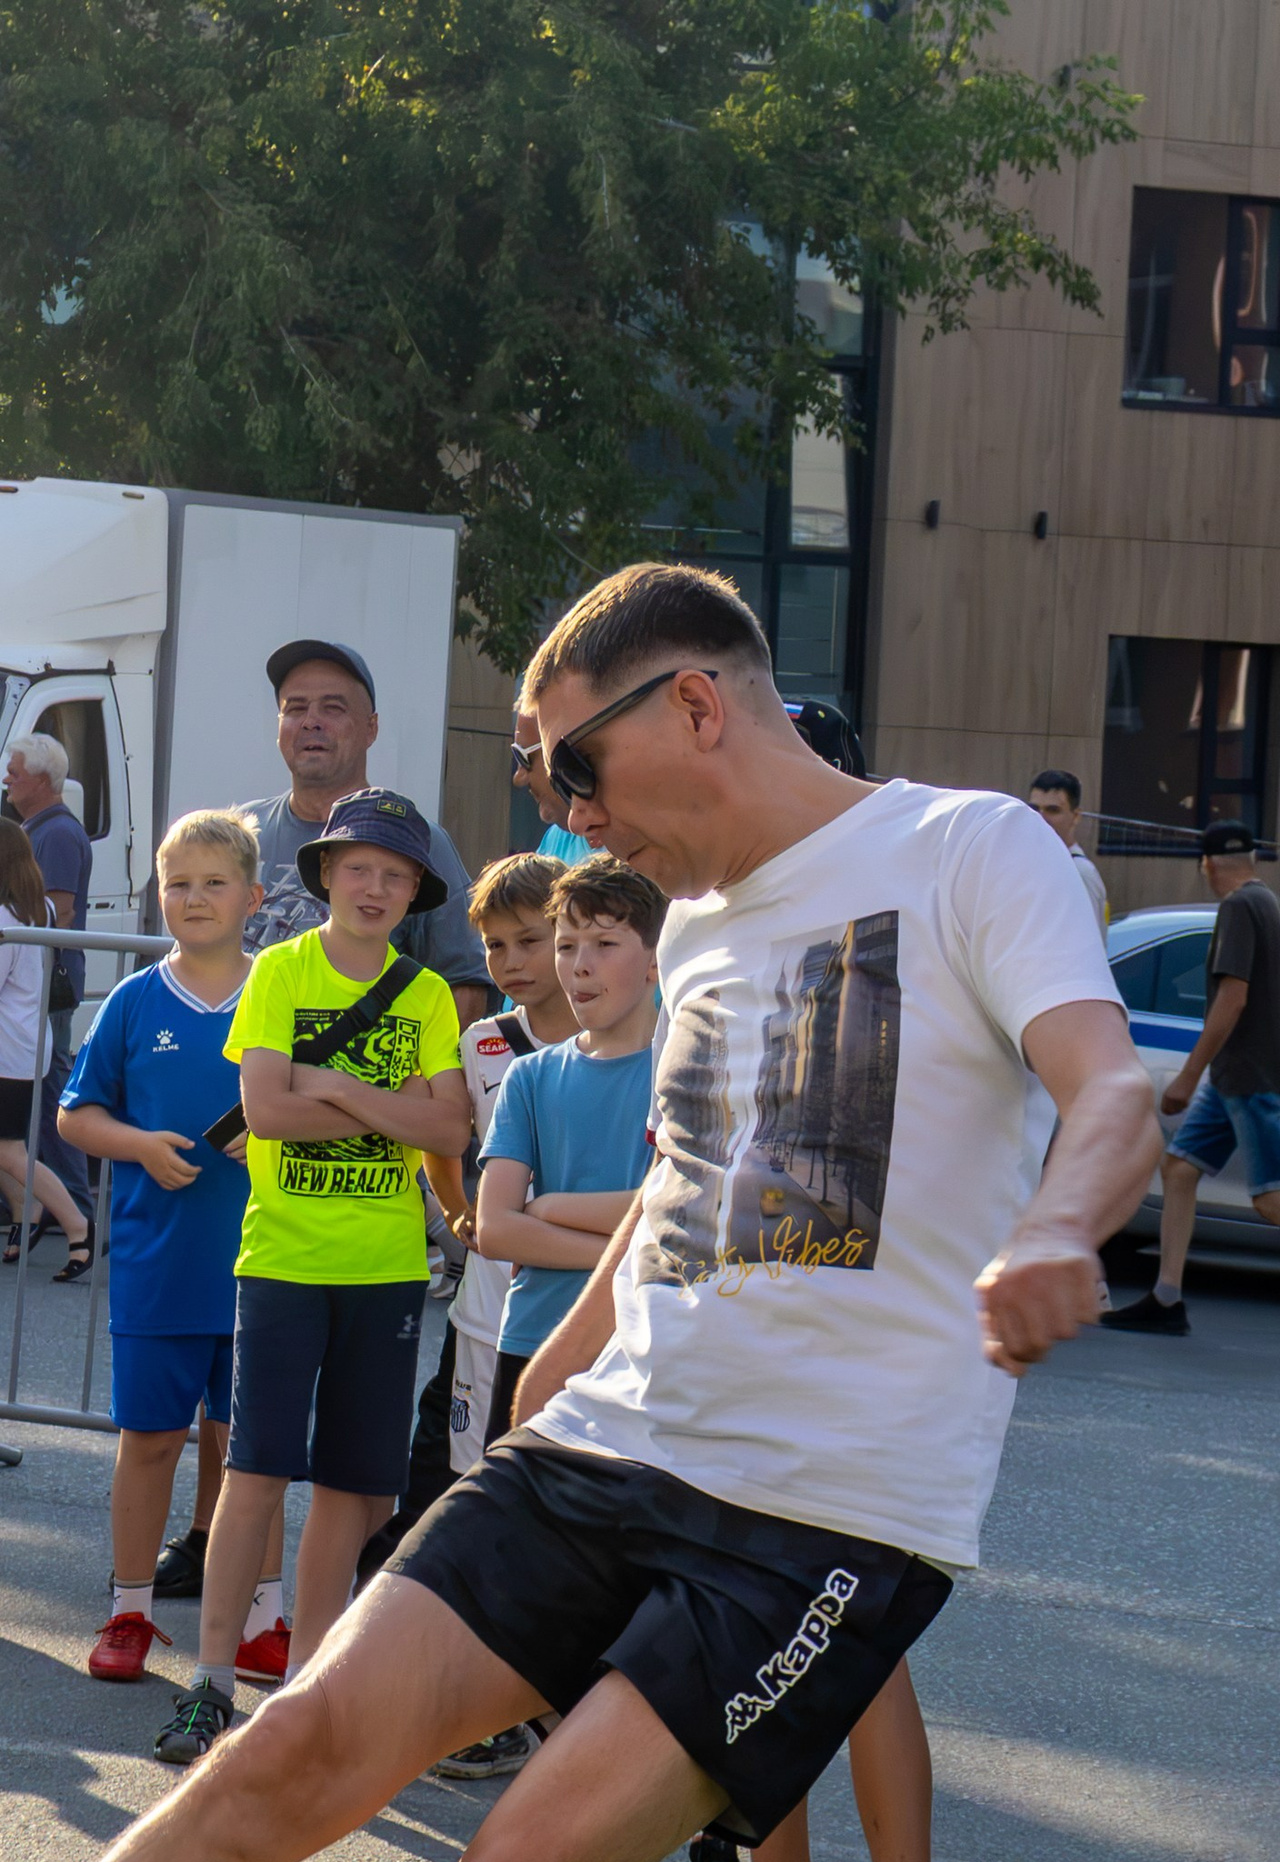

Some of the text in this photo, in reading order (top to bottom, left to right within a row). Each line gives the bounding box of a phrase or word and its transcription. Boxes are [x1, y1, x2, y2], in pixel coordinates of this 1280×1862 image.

[152, 1043, 180, 1053] KELME
[283, 1159, 404, 1194] NEW REALITY
[758, 1214, 871, 1281] Vibes
[756, 1568, 860, 1700] Kappa
